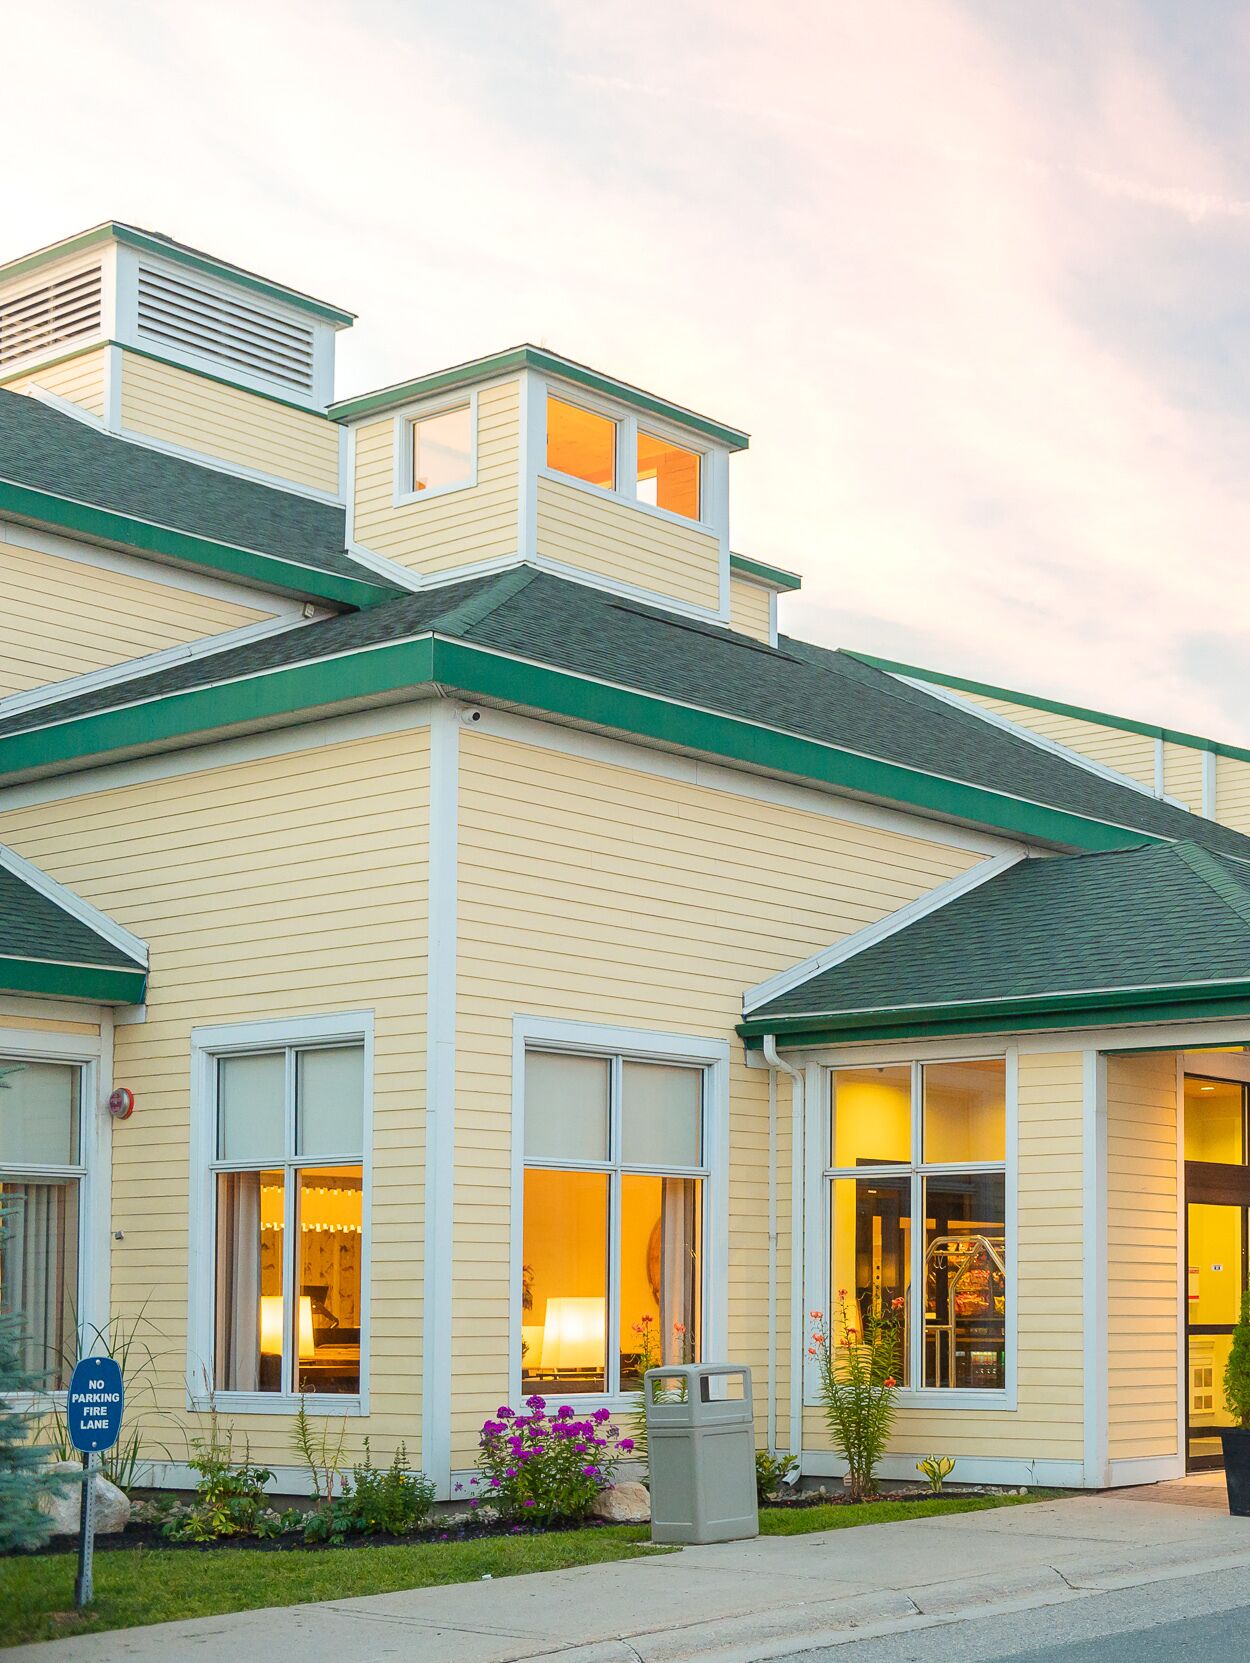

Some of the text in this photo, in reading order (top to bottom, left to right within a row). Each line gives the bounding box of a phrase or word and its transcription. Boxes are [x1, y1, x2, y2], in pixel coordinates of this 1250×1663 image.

[88, 1379, 105, 1390] NO
[72, 1392, 120, 1403] PARKING
[83, 1406, 108, 1416] FIRE
[80, 1419, 109, 1430] LANE
